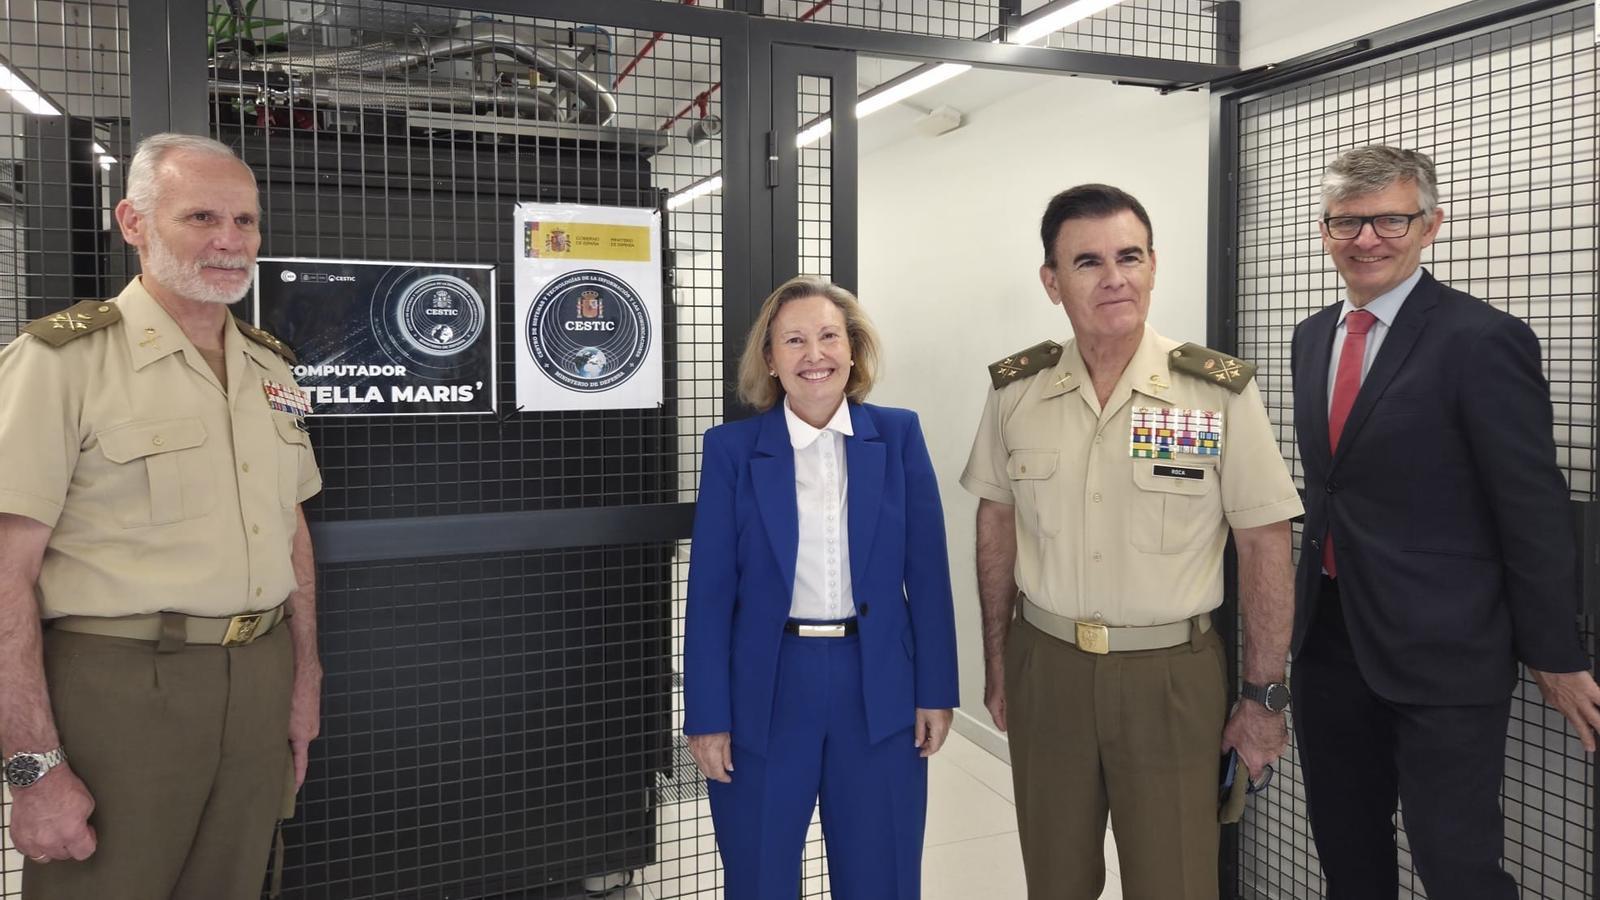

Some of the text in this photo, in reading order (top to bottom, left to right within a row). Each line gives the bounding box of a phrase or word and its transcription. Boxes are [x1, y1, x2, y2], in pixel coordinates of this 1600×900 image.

[426, 308, 459, 316] CESTIC
[564, 321, 615, 331] CESTIC
[300, 385, 384, 404] TELLA
